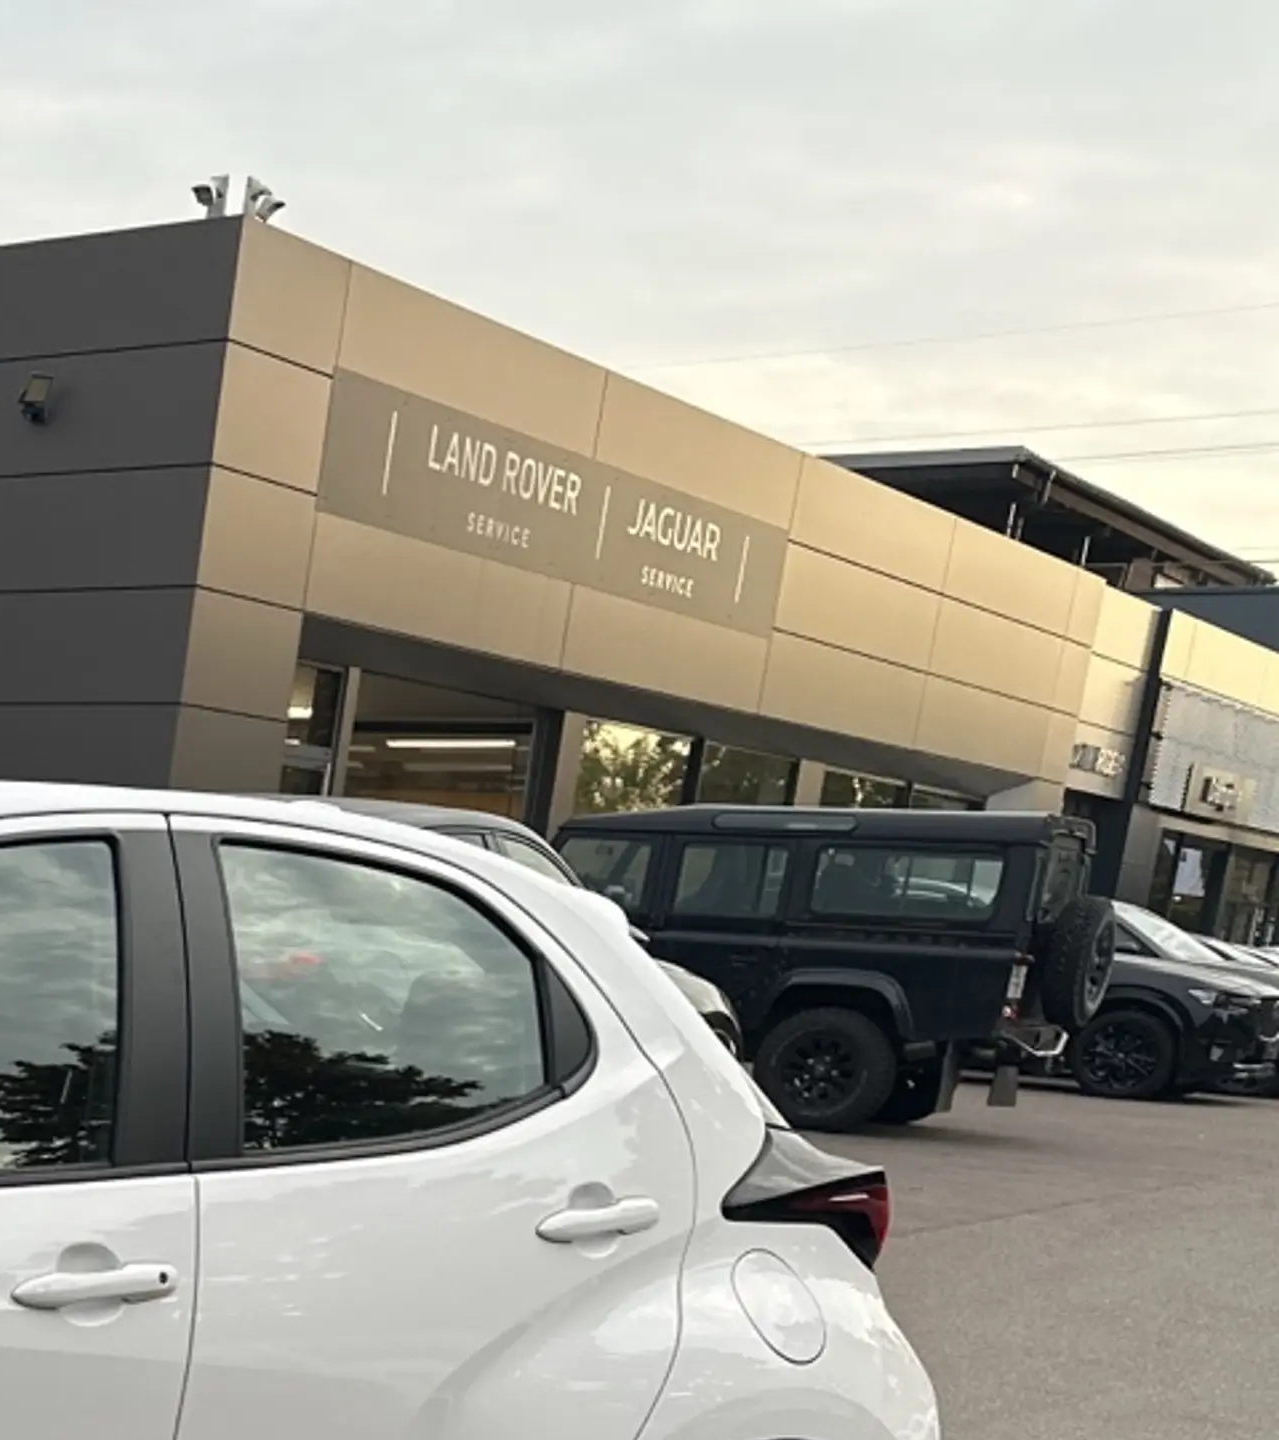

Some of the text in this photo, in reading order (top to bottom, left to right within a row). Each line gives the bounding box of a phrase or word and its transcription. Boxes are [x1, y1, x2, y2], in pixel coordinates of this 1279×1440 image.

[428, 424, 582, 516] LAND ROVER
[466, 511, 531, 549] SERVICE
[626, 498, 721, 562] JAGUAR
[641, 565, 695, 599] SERVICE
